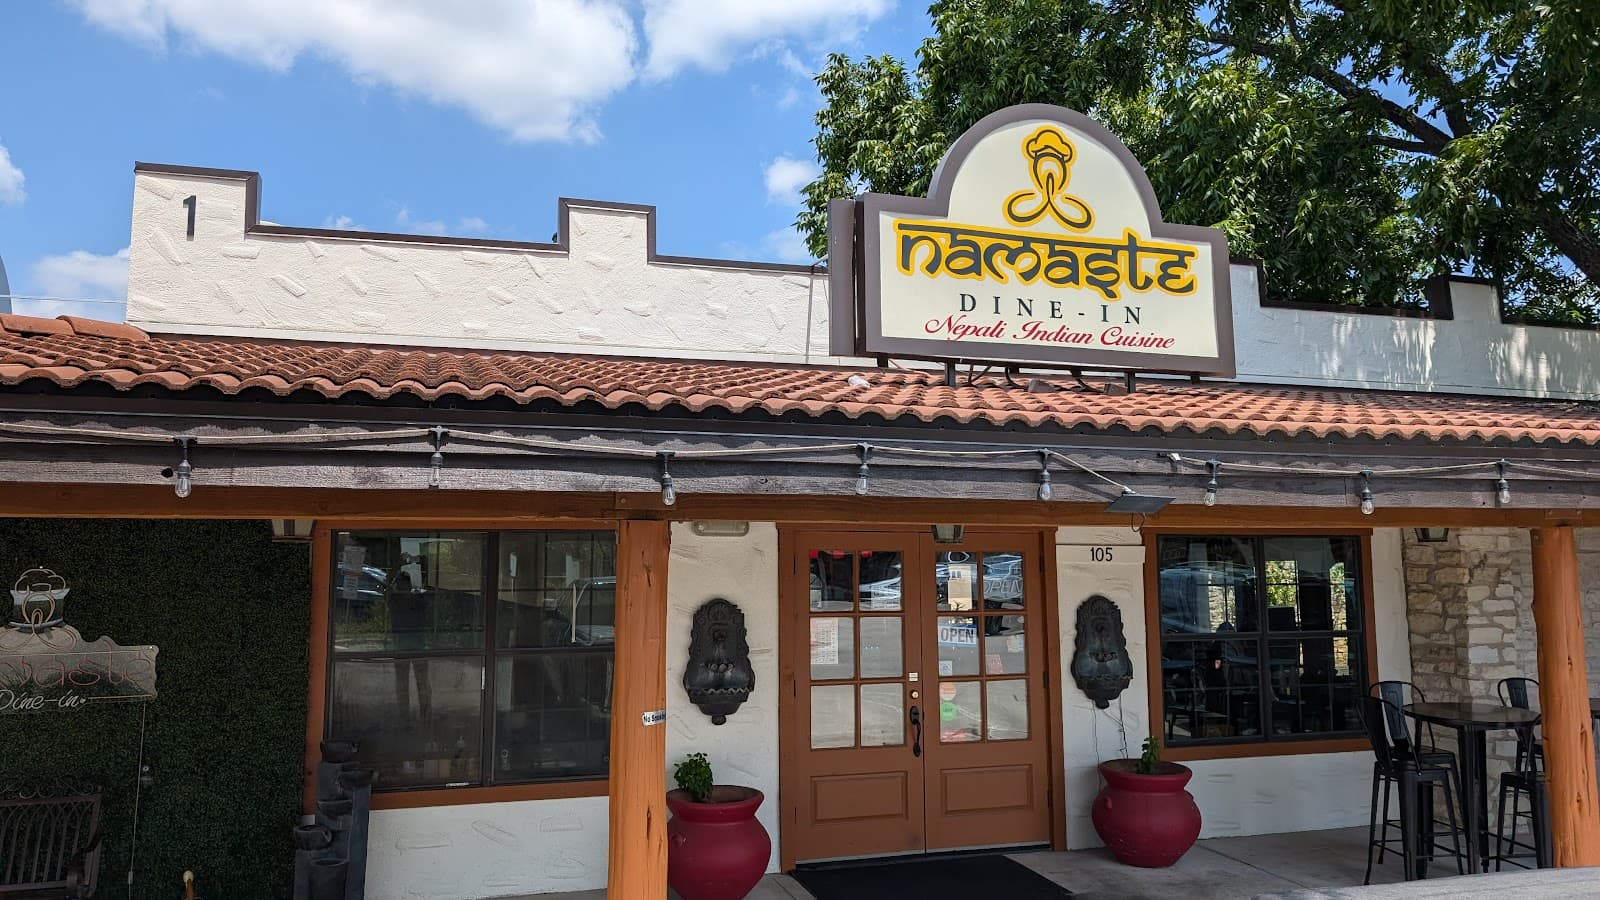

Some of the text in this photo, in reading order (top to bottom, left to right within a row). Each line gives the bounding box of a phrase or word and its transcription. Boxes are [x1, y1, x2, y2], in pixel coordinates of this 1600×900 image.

[182, 194, 197, 241] 1
[959, 293, 1142, 325] DINE-IN
[924, 314, 1176, 349] Nepali Indian Cuisine
[1089, 546, 1113, 562] 105
[940, 627, 975, 644] OPEN
